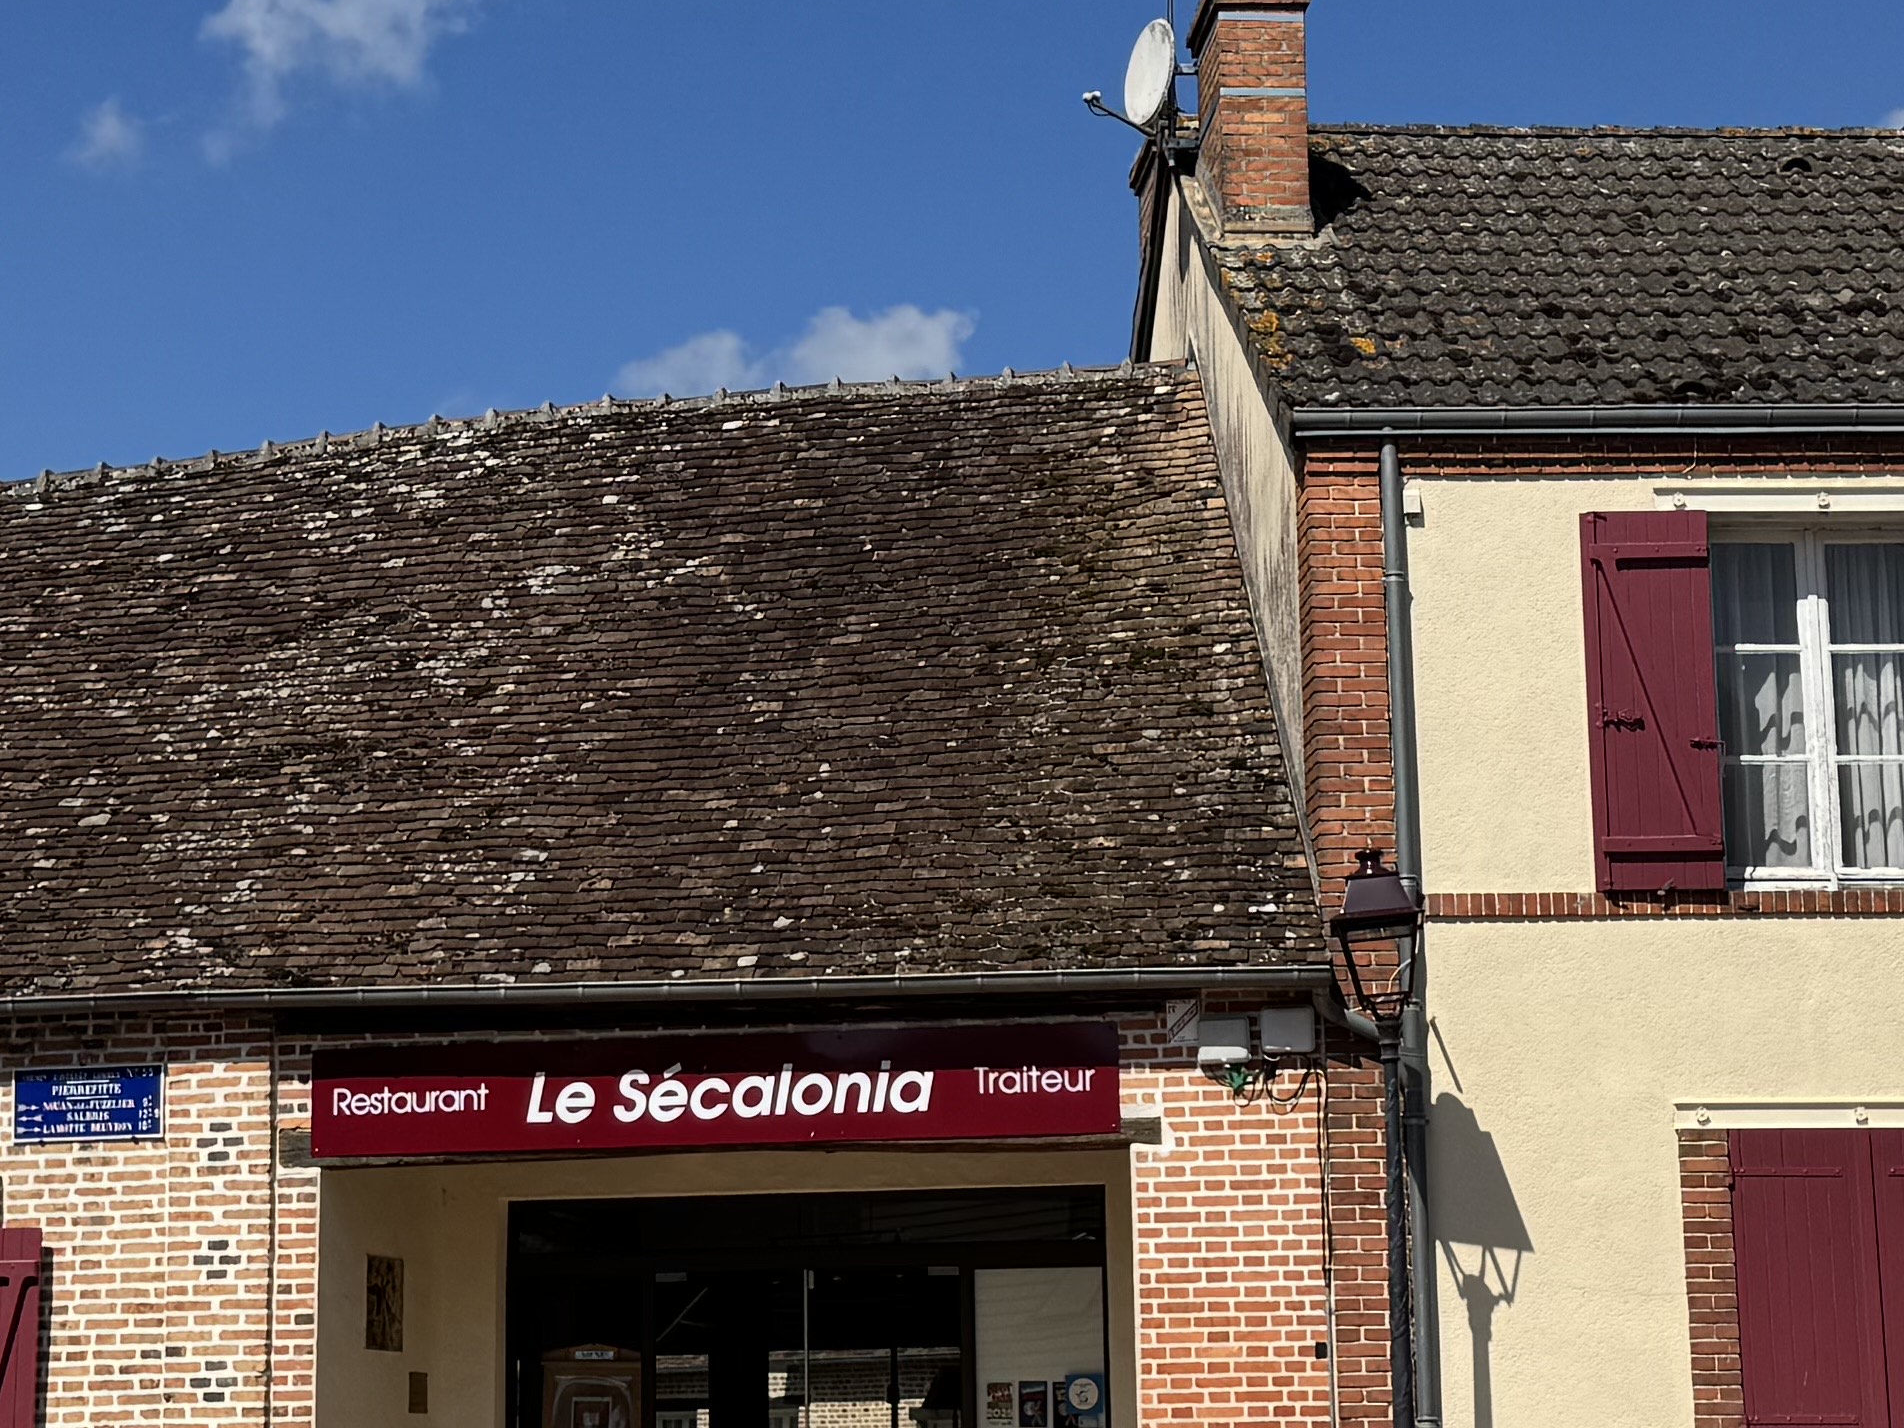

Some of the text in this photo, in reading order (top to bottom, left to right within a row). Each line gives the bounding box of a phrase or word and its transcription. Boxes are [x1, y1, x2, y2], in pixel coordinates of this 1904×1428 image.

[332, 1060, 1096, 1124] Restaurant Le Sécalonia Traiteur
